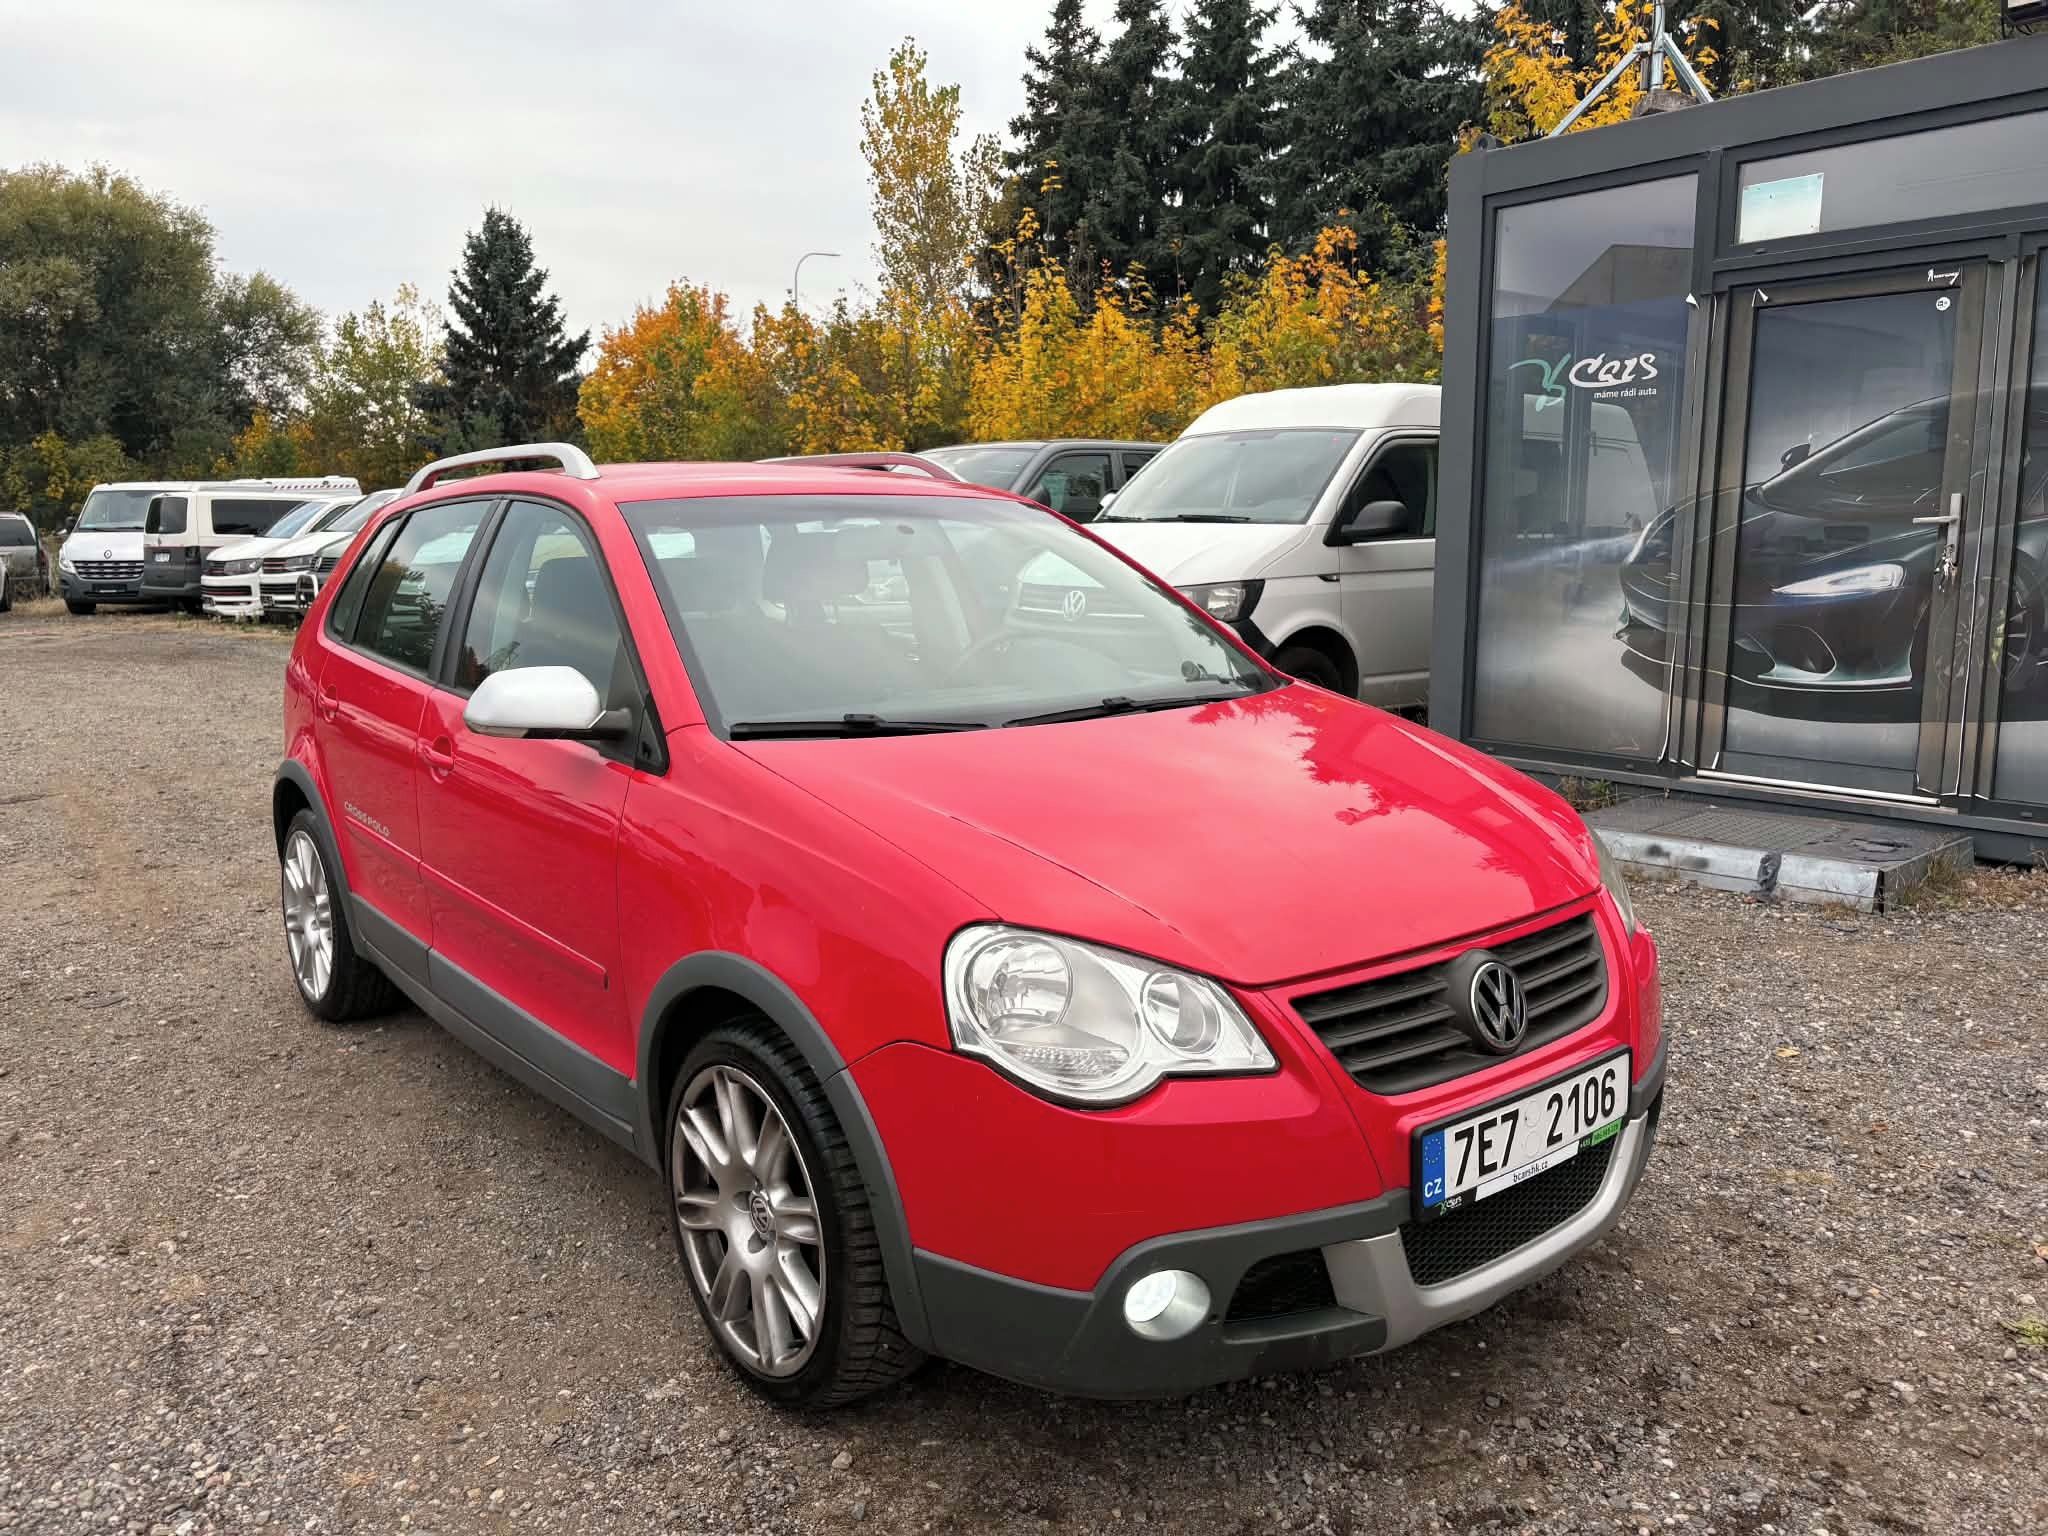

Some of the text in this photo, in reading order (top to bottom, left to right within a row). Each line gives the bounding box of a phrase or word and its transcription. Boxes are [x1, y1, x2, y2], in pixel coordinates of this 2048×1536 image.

[1638, 387, 1657, 396] auta
[1454, 1068, 1616, 1187] 7E7 2106
[1424, 1177, 1442, 1198] CZ
